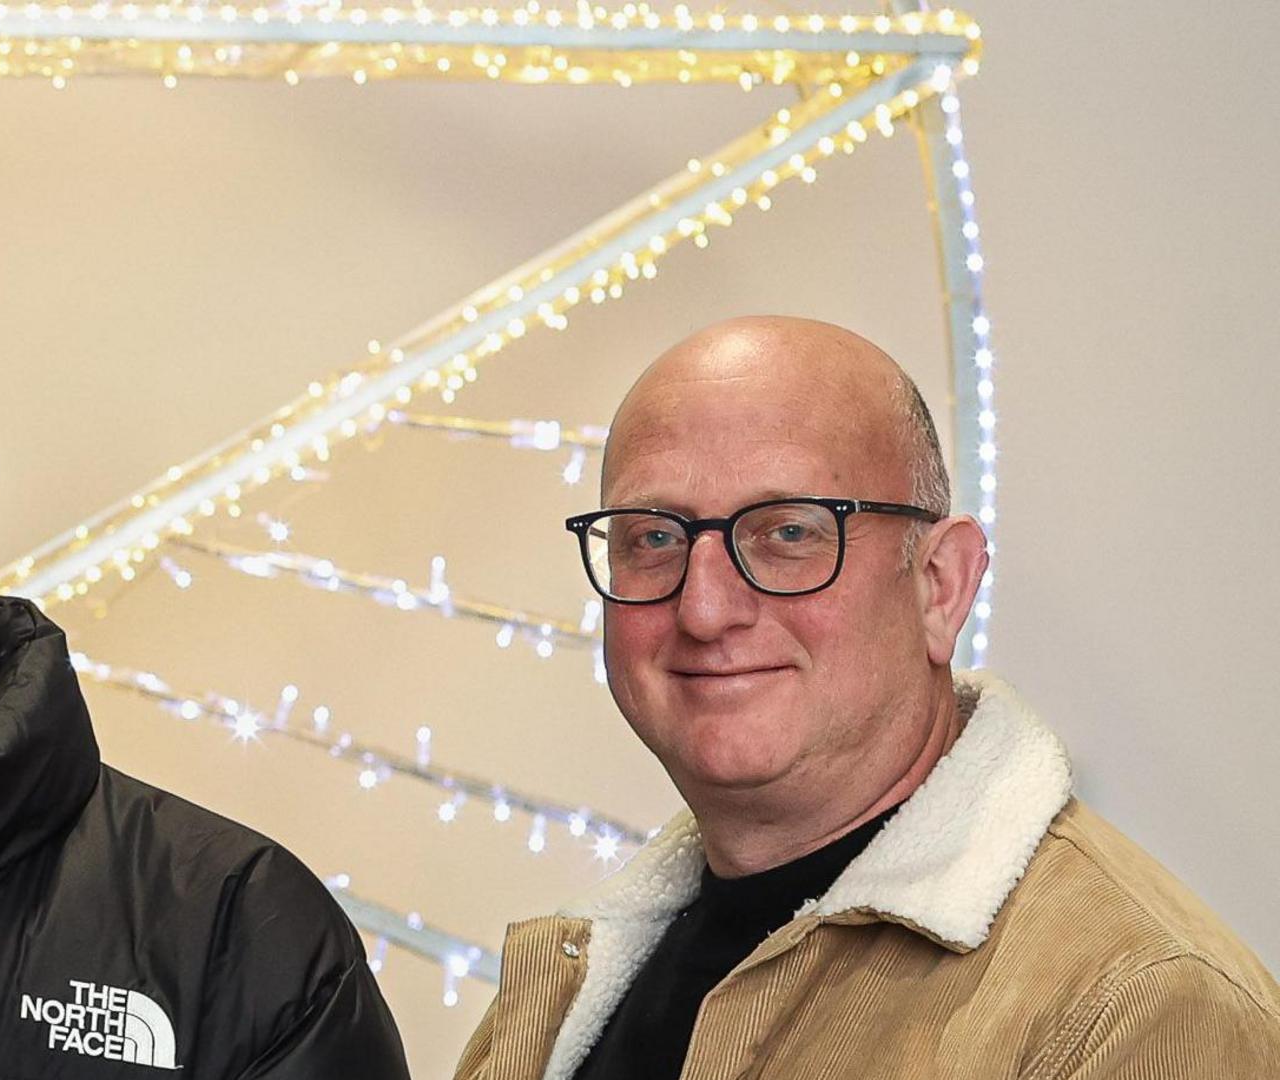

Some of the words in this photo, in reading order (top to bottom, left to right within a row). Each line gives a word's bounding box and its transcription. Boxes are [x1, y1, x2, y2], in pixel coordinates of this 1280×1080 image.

[69, 979, 128, 1013] THE
[20, 994, 125, 1037] NORTH
[48, 1023, 125, 1061] FACE
